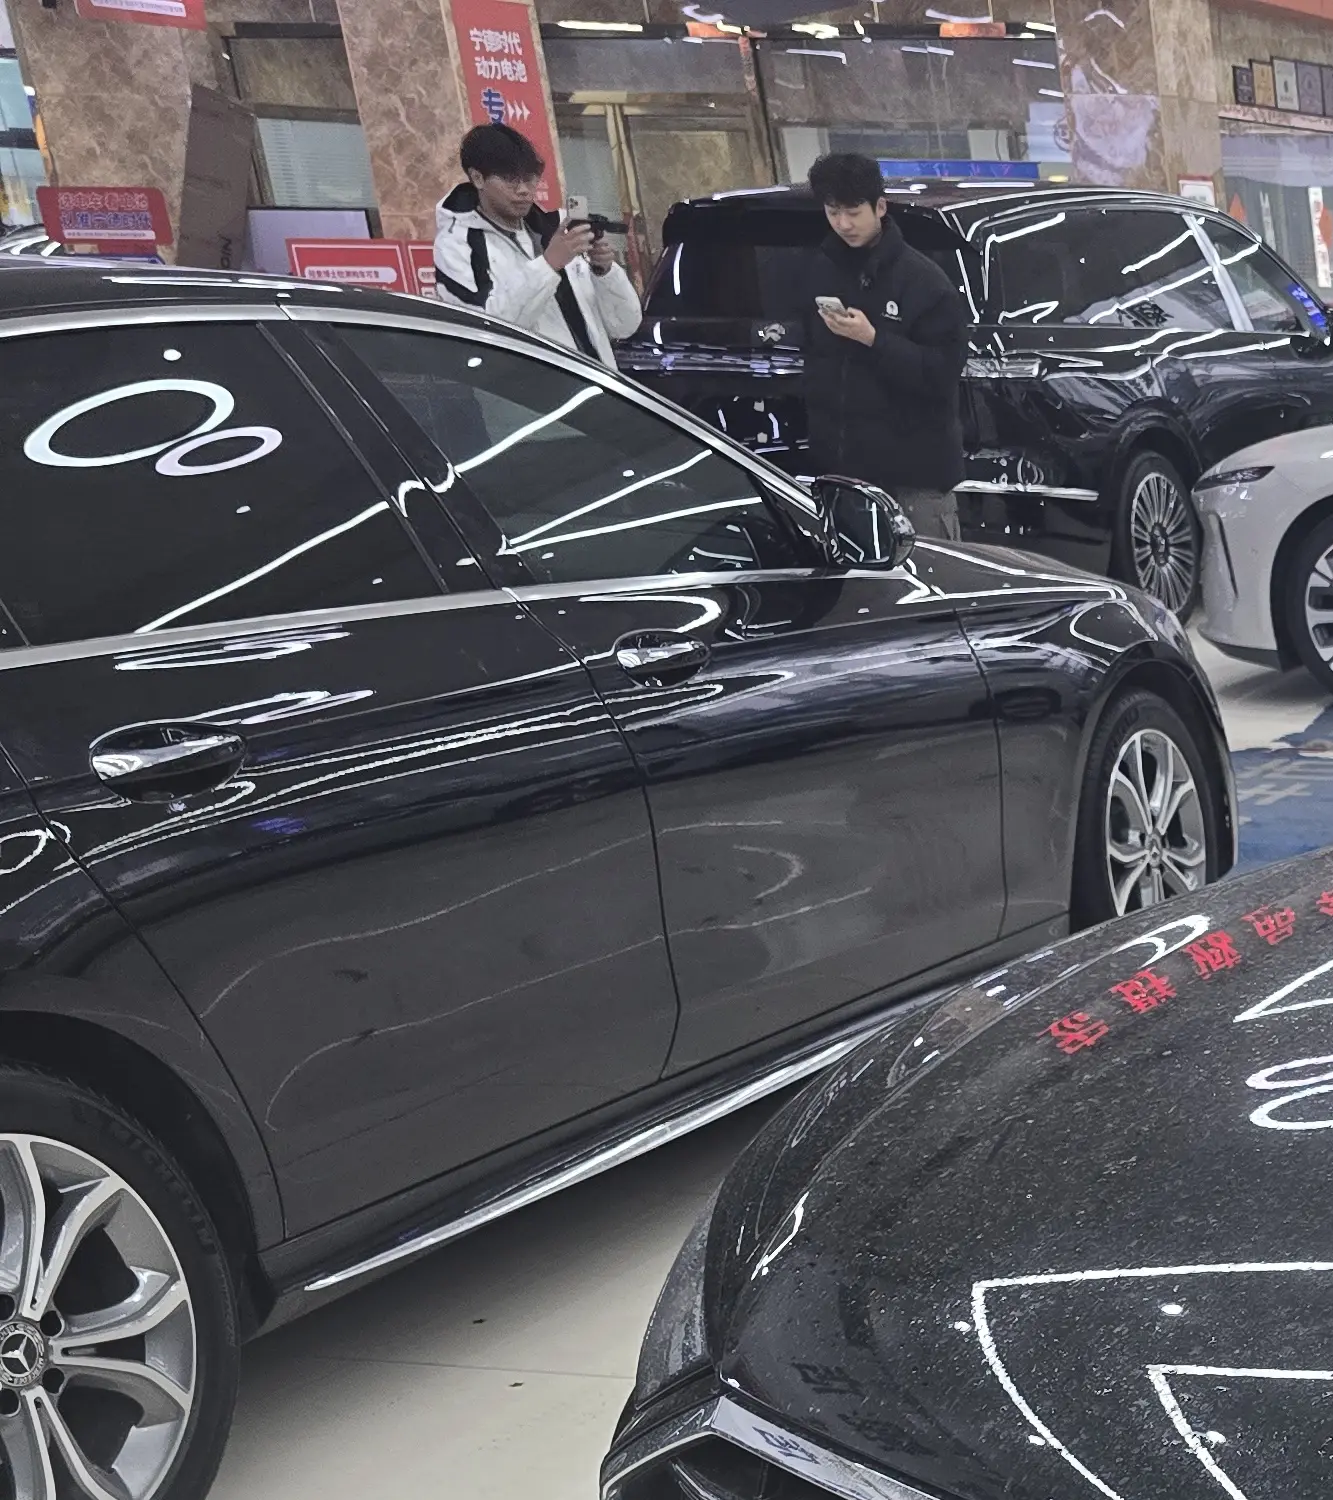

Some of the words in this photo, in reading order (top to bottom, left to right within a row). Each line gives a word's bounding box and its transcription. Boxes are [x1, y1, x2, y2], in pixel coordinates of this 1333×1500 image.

[469, 28, 523, 56] 宁德时代
[474, 56, 528, 83] 动力电池
